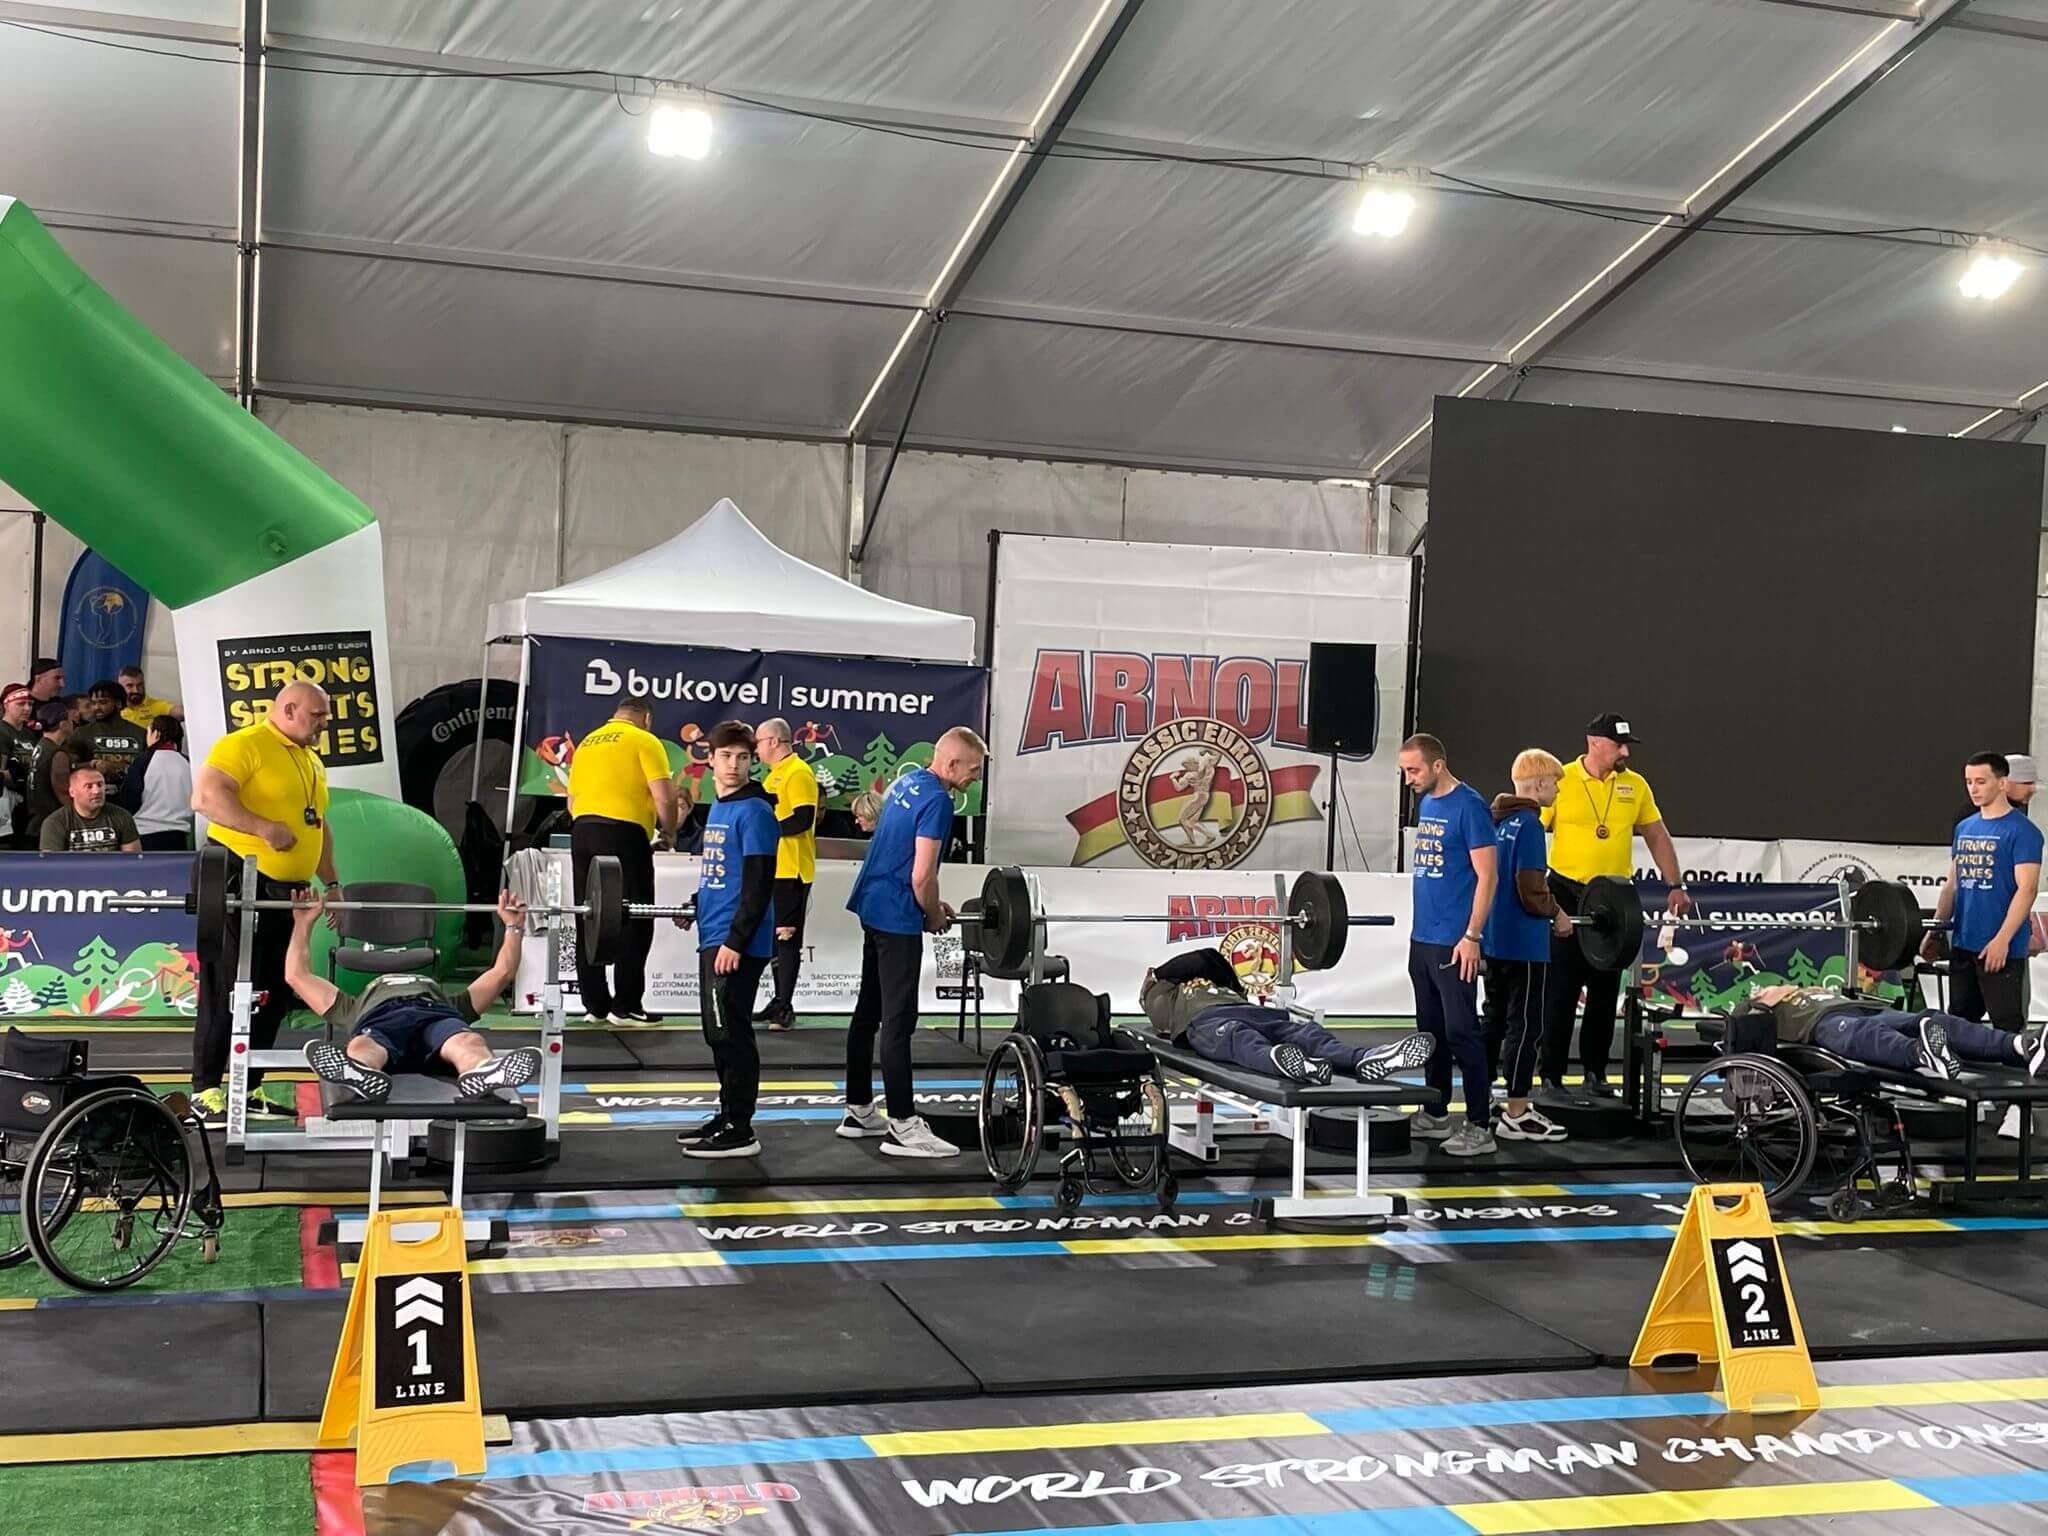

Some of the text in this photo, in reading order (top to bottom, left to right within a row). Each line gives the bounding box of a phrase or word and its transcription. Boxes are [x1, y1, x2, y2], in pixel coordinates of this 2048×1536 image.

[242, 646, 285, 656] ARNOLD
[290, 643, 334, 652] CLASSIC
[226, 656, 371, 692] STRONG
[628, 669, 768, 705] bukovel
[790, 684, 934, 715] summer
[1017, 648, 1380, 762] ARNOL
[106, 739, 129, 749] 059
[1121, 721, 1266, 803] CLASSIC EUROPE
[81, 830, 104, 842] 130
[697, 1221, 889, 1240] WORLD
[900, 1213, 1211, 1235] STRONGMAN
[1741, 1283, 1770, 1323] 2
[407, 1329, 432, 1376] 1
[1743, 1329, 1780, 1342] LINE
[395, 1382, 446, 1398] LINE
[901, 1468, 1181, 1508] WORLD
[1203, 1453, 1638, 1488] STRONGMAN
